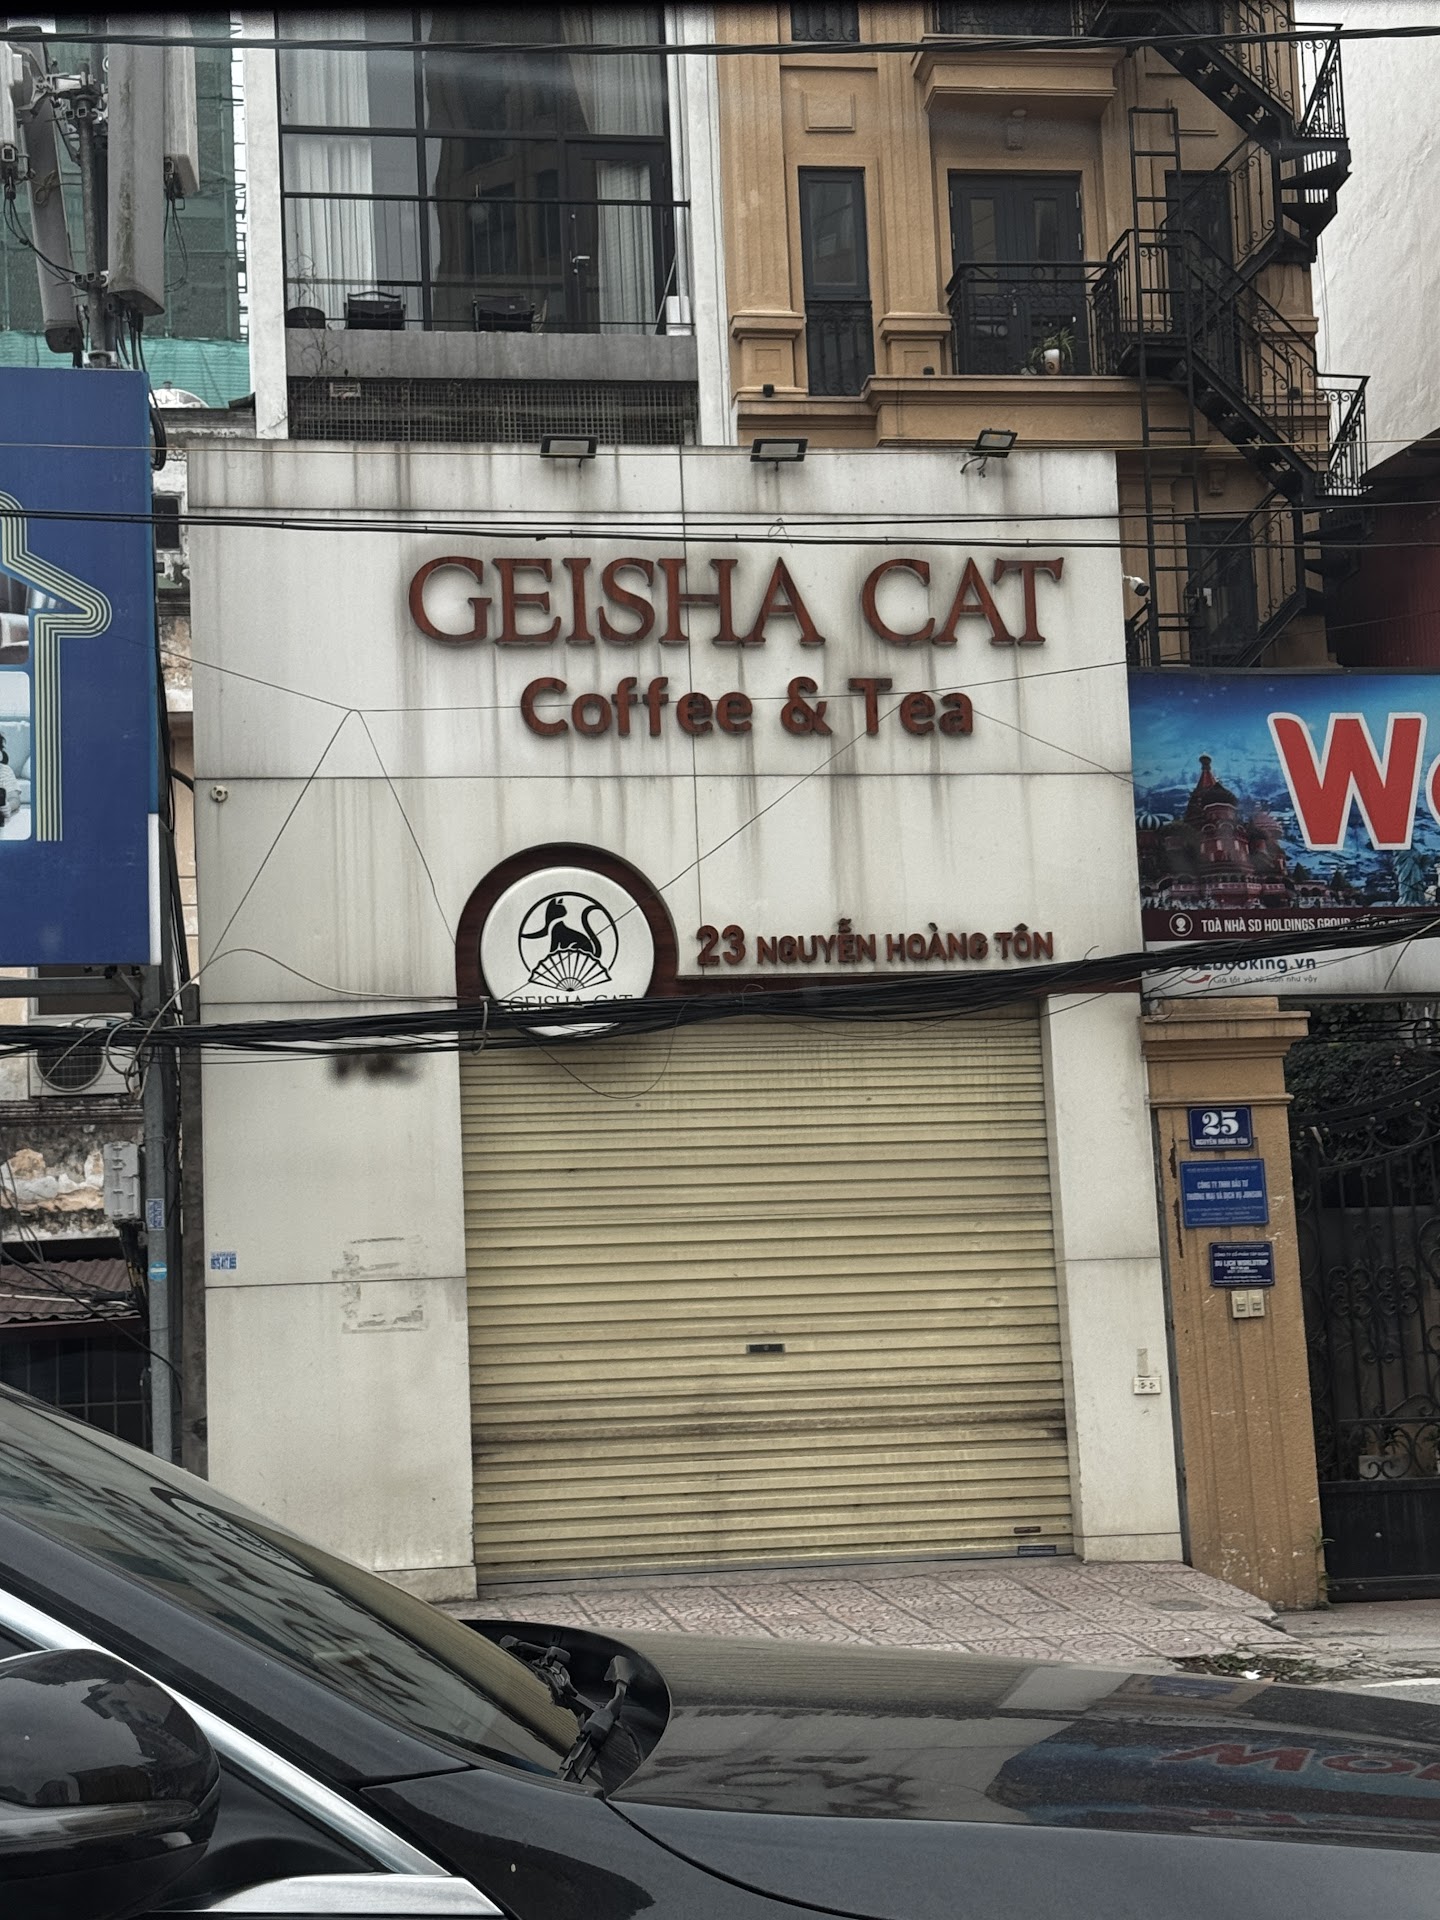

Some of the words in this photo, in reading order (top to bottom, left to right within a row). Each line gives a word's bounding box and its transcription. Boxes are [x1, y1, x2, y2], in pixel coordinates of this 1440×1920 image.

[409, 556, 825, 646] GEISHA
[862, 557, 1064, 646] CAT
[521, 677, 753, 737] Coffee
[780, 677, 832, 737] &
[848, 678, 974, 737] Tea
[1267, 712, 1440, 851] W
[696, 924, 746, 966] 23
[757, 918, 878, 965] NGUYỄN
[885, 922, 989, 962] HOÀNG
[994, 922, 1054, 960] TÔN
[1201, 917, 1223, 933] TOÀ
[1224, 916, 1247, 932] NHÀ
[1248, 919, 1262, 932] SD
[1264, 918, 1316, 932] HOLDINGS
[1201, 1110, 1239, 1136] 25
